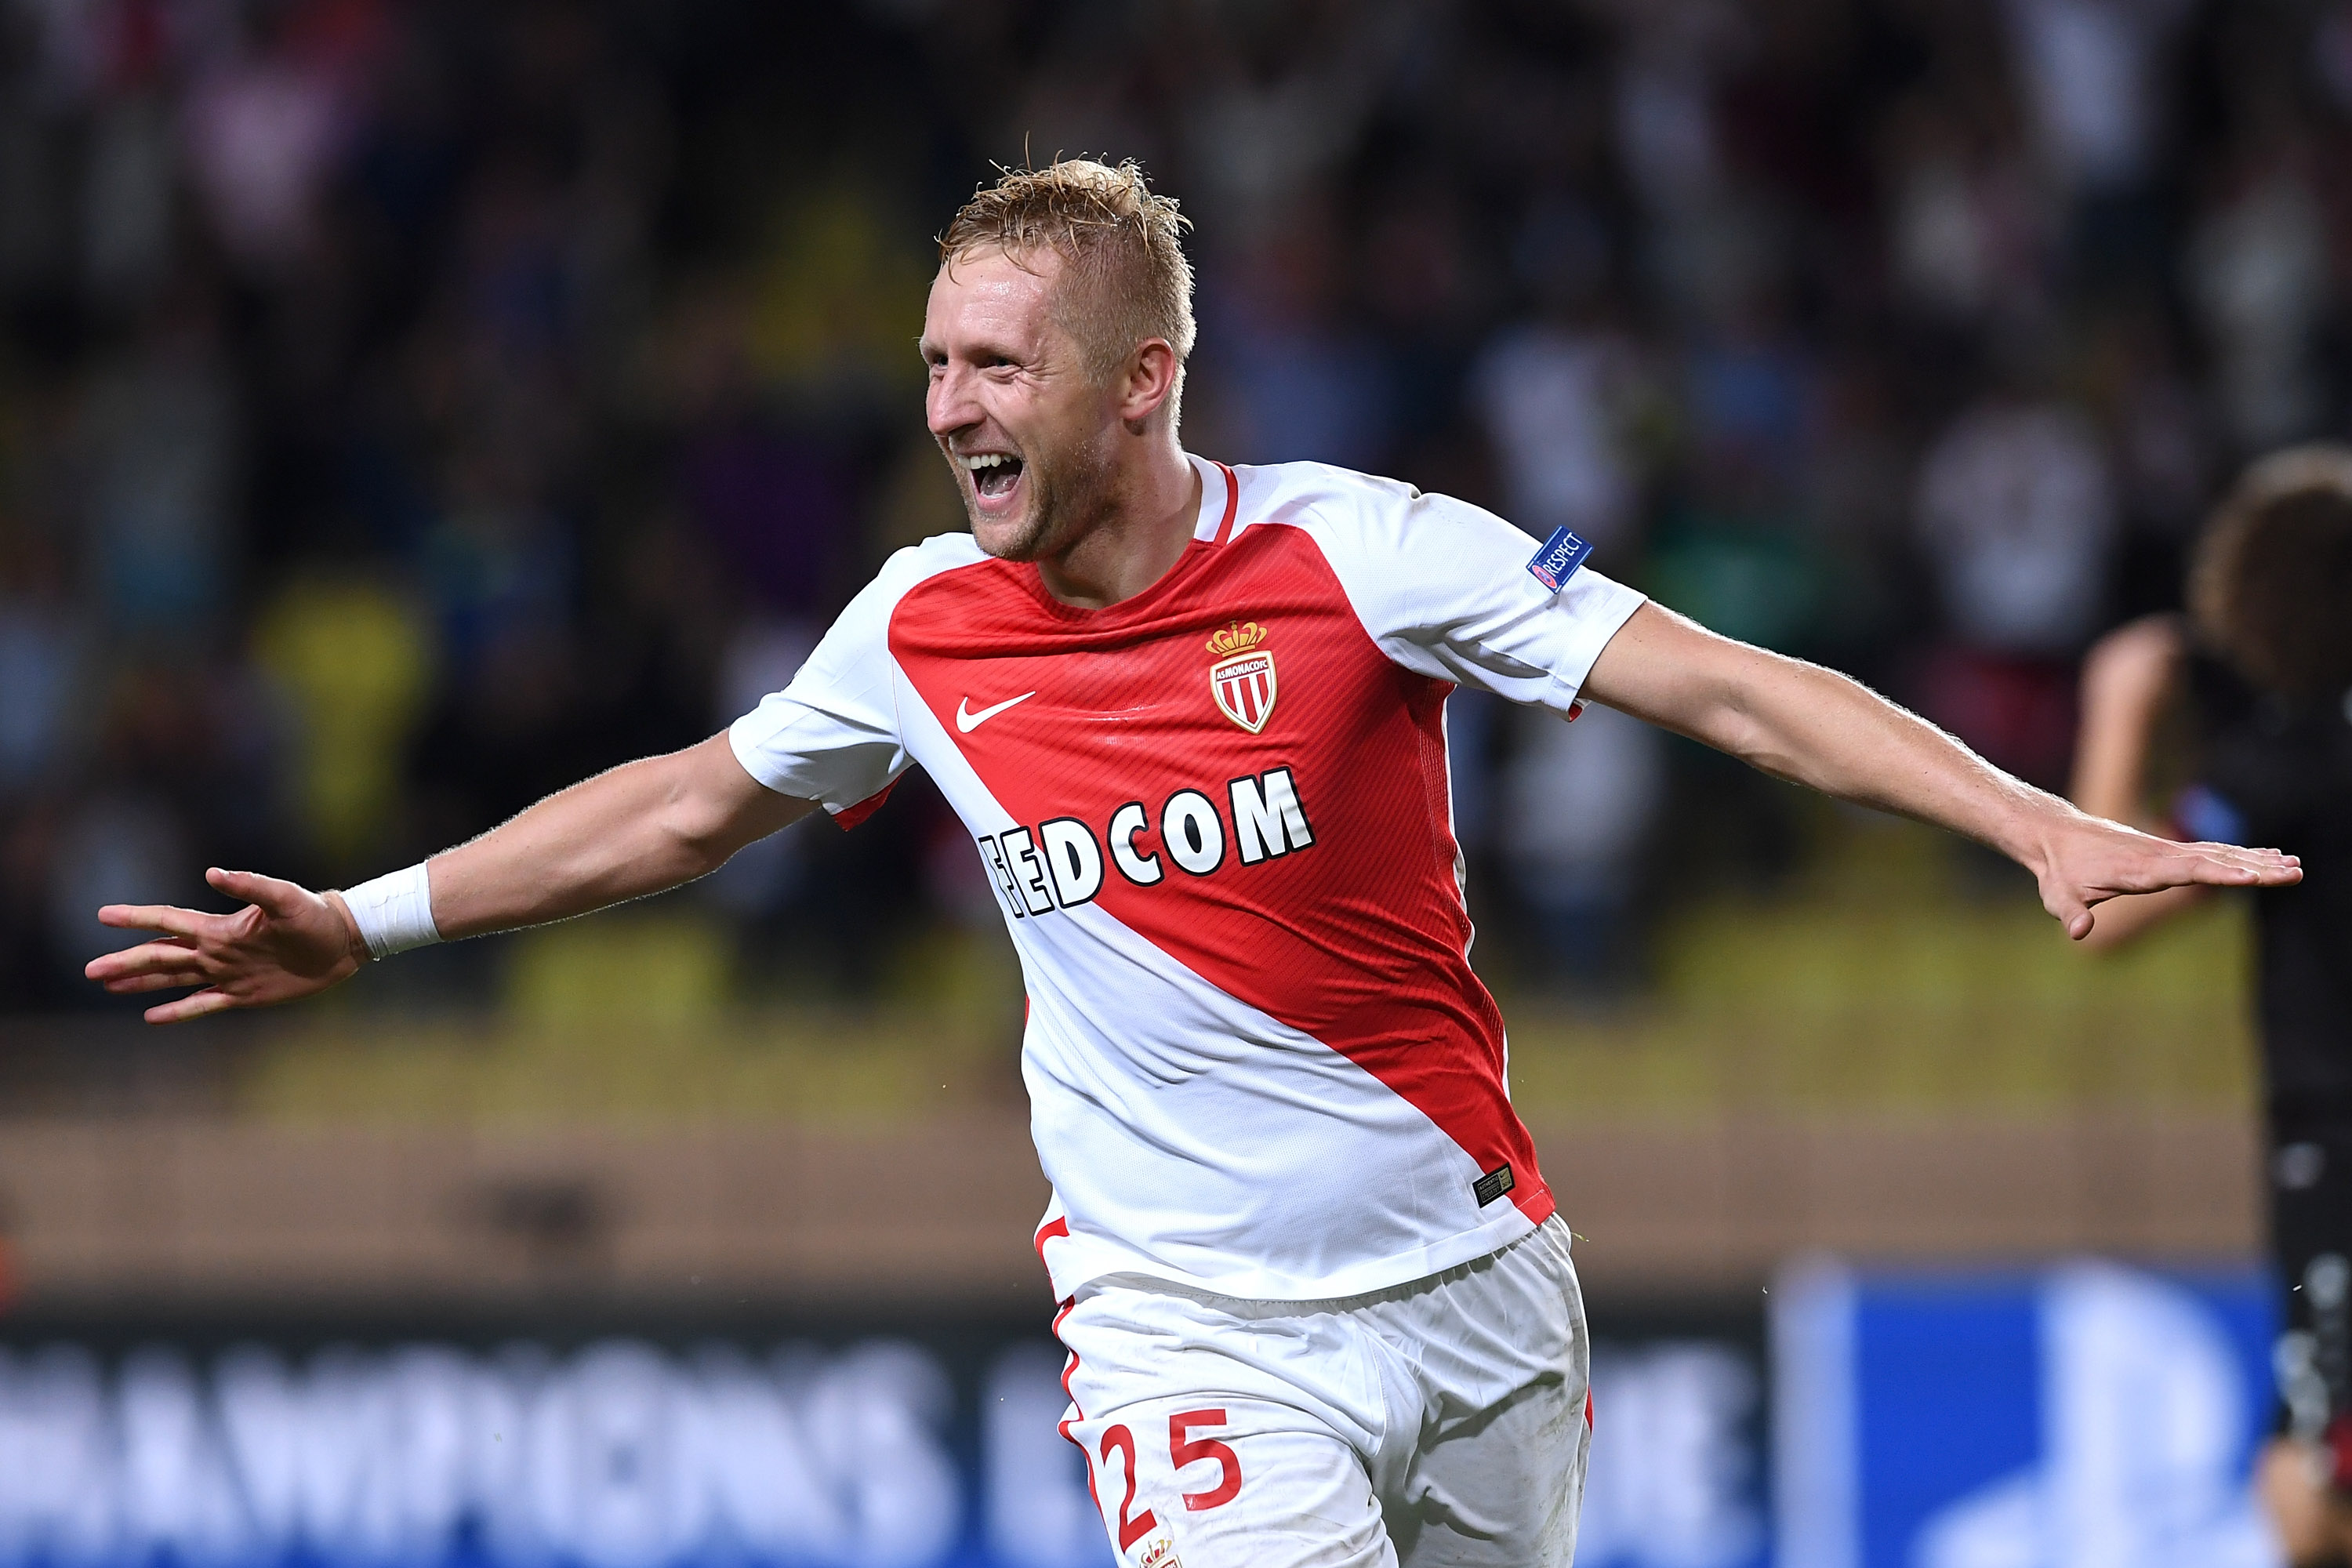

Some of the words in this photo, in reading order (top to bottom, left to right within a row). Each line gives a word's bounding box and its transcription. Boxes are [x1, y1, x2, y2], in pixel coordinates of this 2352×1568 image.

[1542, 532, 1583, 577] RESPECT
[978, 766, 1316, 919] FEDCOM
[1100, 1409, 1242, 1555] 25
